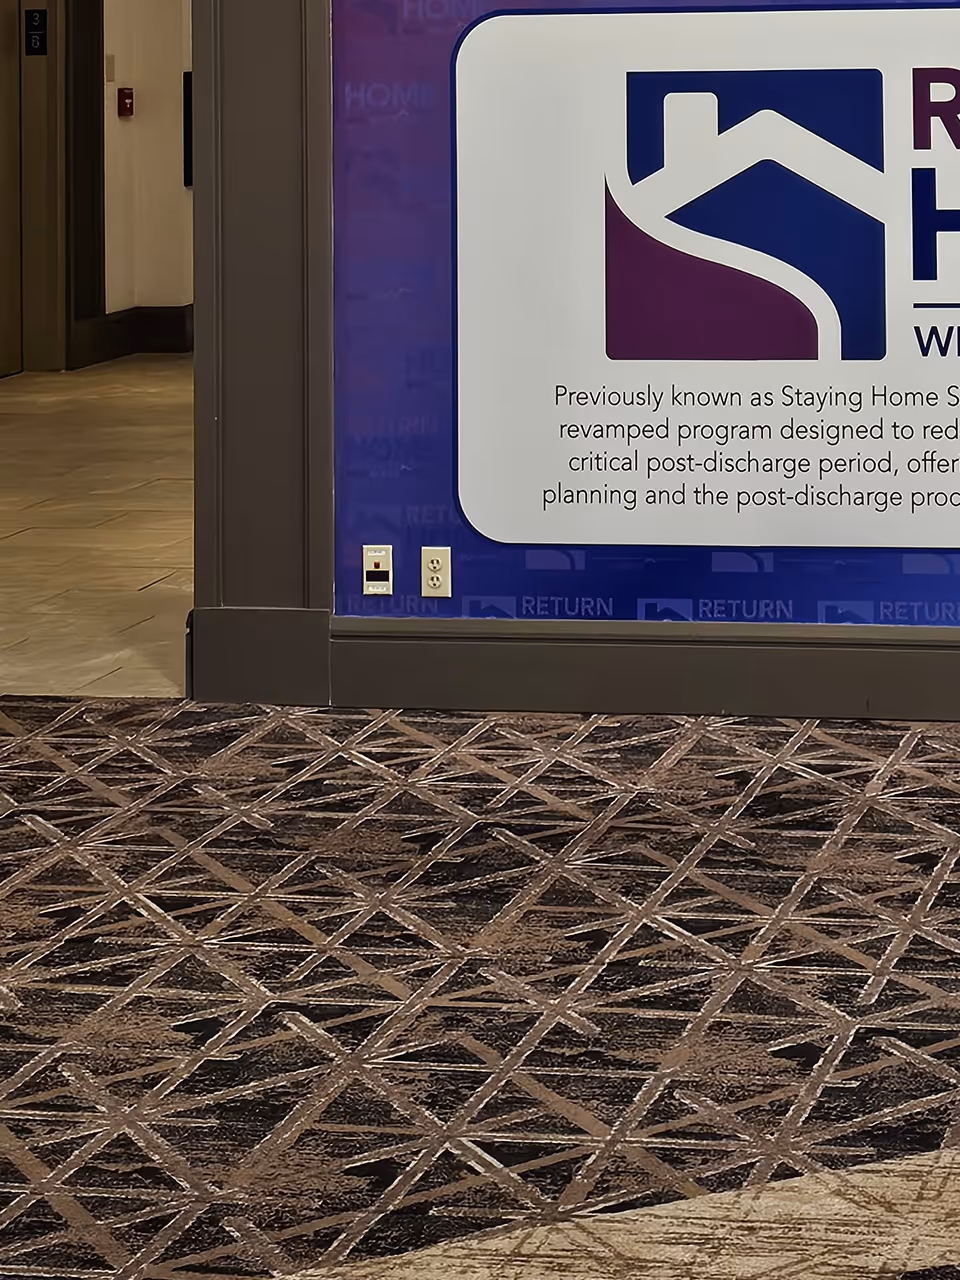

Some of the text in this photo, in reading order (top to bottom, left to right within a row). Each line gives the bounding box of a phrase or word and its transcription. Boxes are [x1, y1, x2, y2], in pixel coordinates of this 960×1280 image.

[555, 383, 665, 413] Previously
[671, 383, 742, 407] known
[750, 391, 774, 408] as
[781, 384, 863, 414] Staying
[871, 384, 941, 408] Home
[559, 415, 671, 447] revamped
[677, 423, 772, 447] program
[779, 415, 885, 447] designed
[889, 421, 915, 440] to
[567, 449, 639, 477] critical
[647, 448, 812, 481] post-discharge
[818, 450, 900, 481] period,
[542, 481, 637, 512] planning
[644, 480, 688, 506] and
[691, 482, 730, 506] the
[736, 483, 905, 514] post-discharge
[521, 596, 613, 617] RETURN
[699, 599, 793, 619] RETURN
